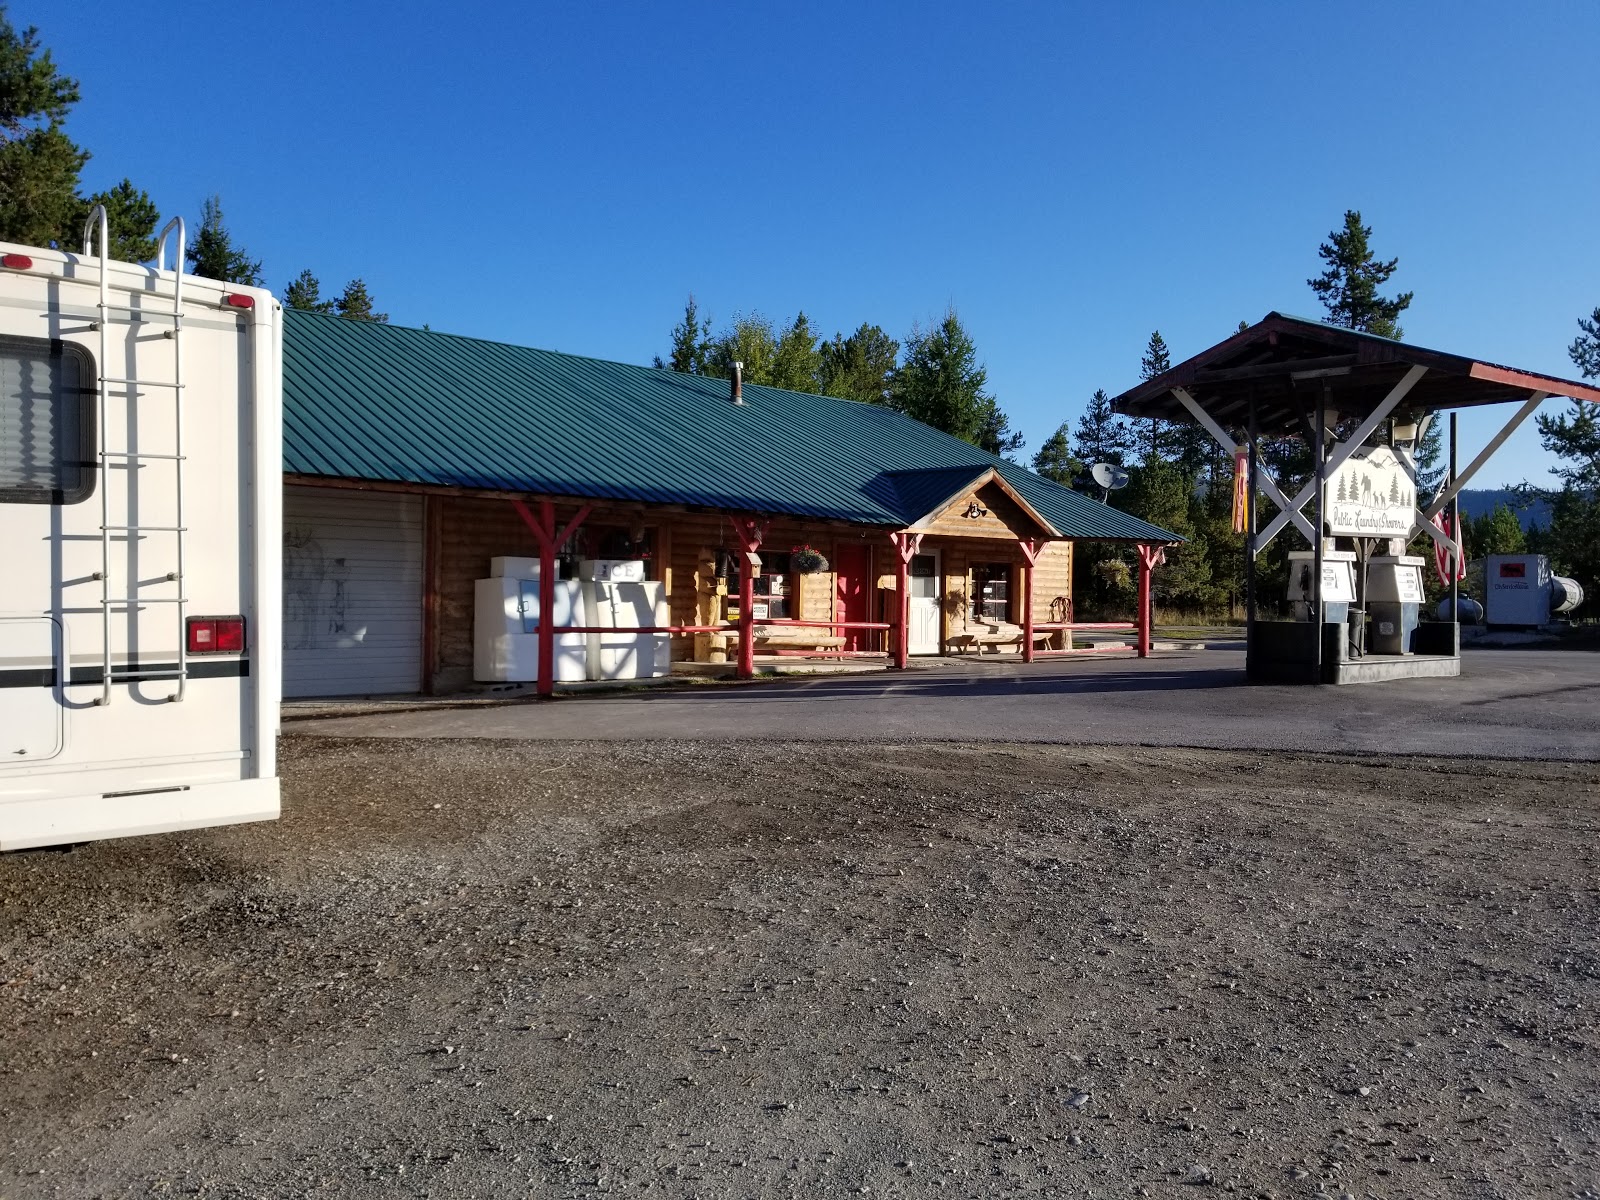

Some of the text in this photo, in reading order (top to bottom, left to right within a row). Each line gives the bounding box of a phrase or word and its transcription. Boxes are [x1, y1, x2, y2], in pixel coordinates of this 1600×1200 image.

[1333, 506, 1353, 526] Public
[1355, 510, 1379, 532] Laundry
[1381, 512, 1407, 530] Showers
[602, 564, 635, 578] ICE
